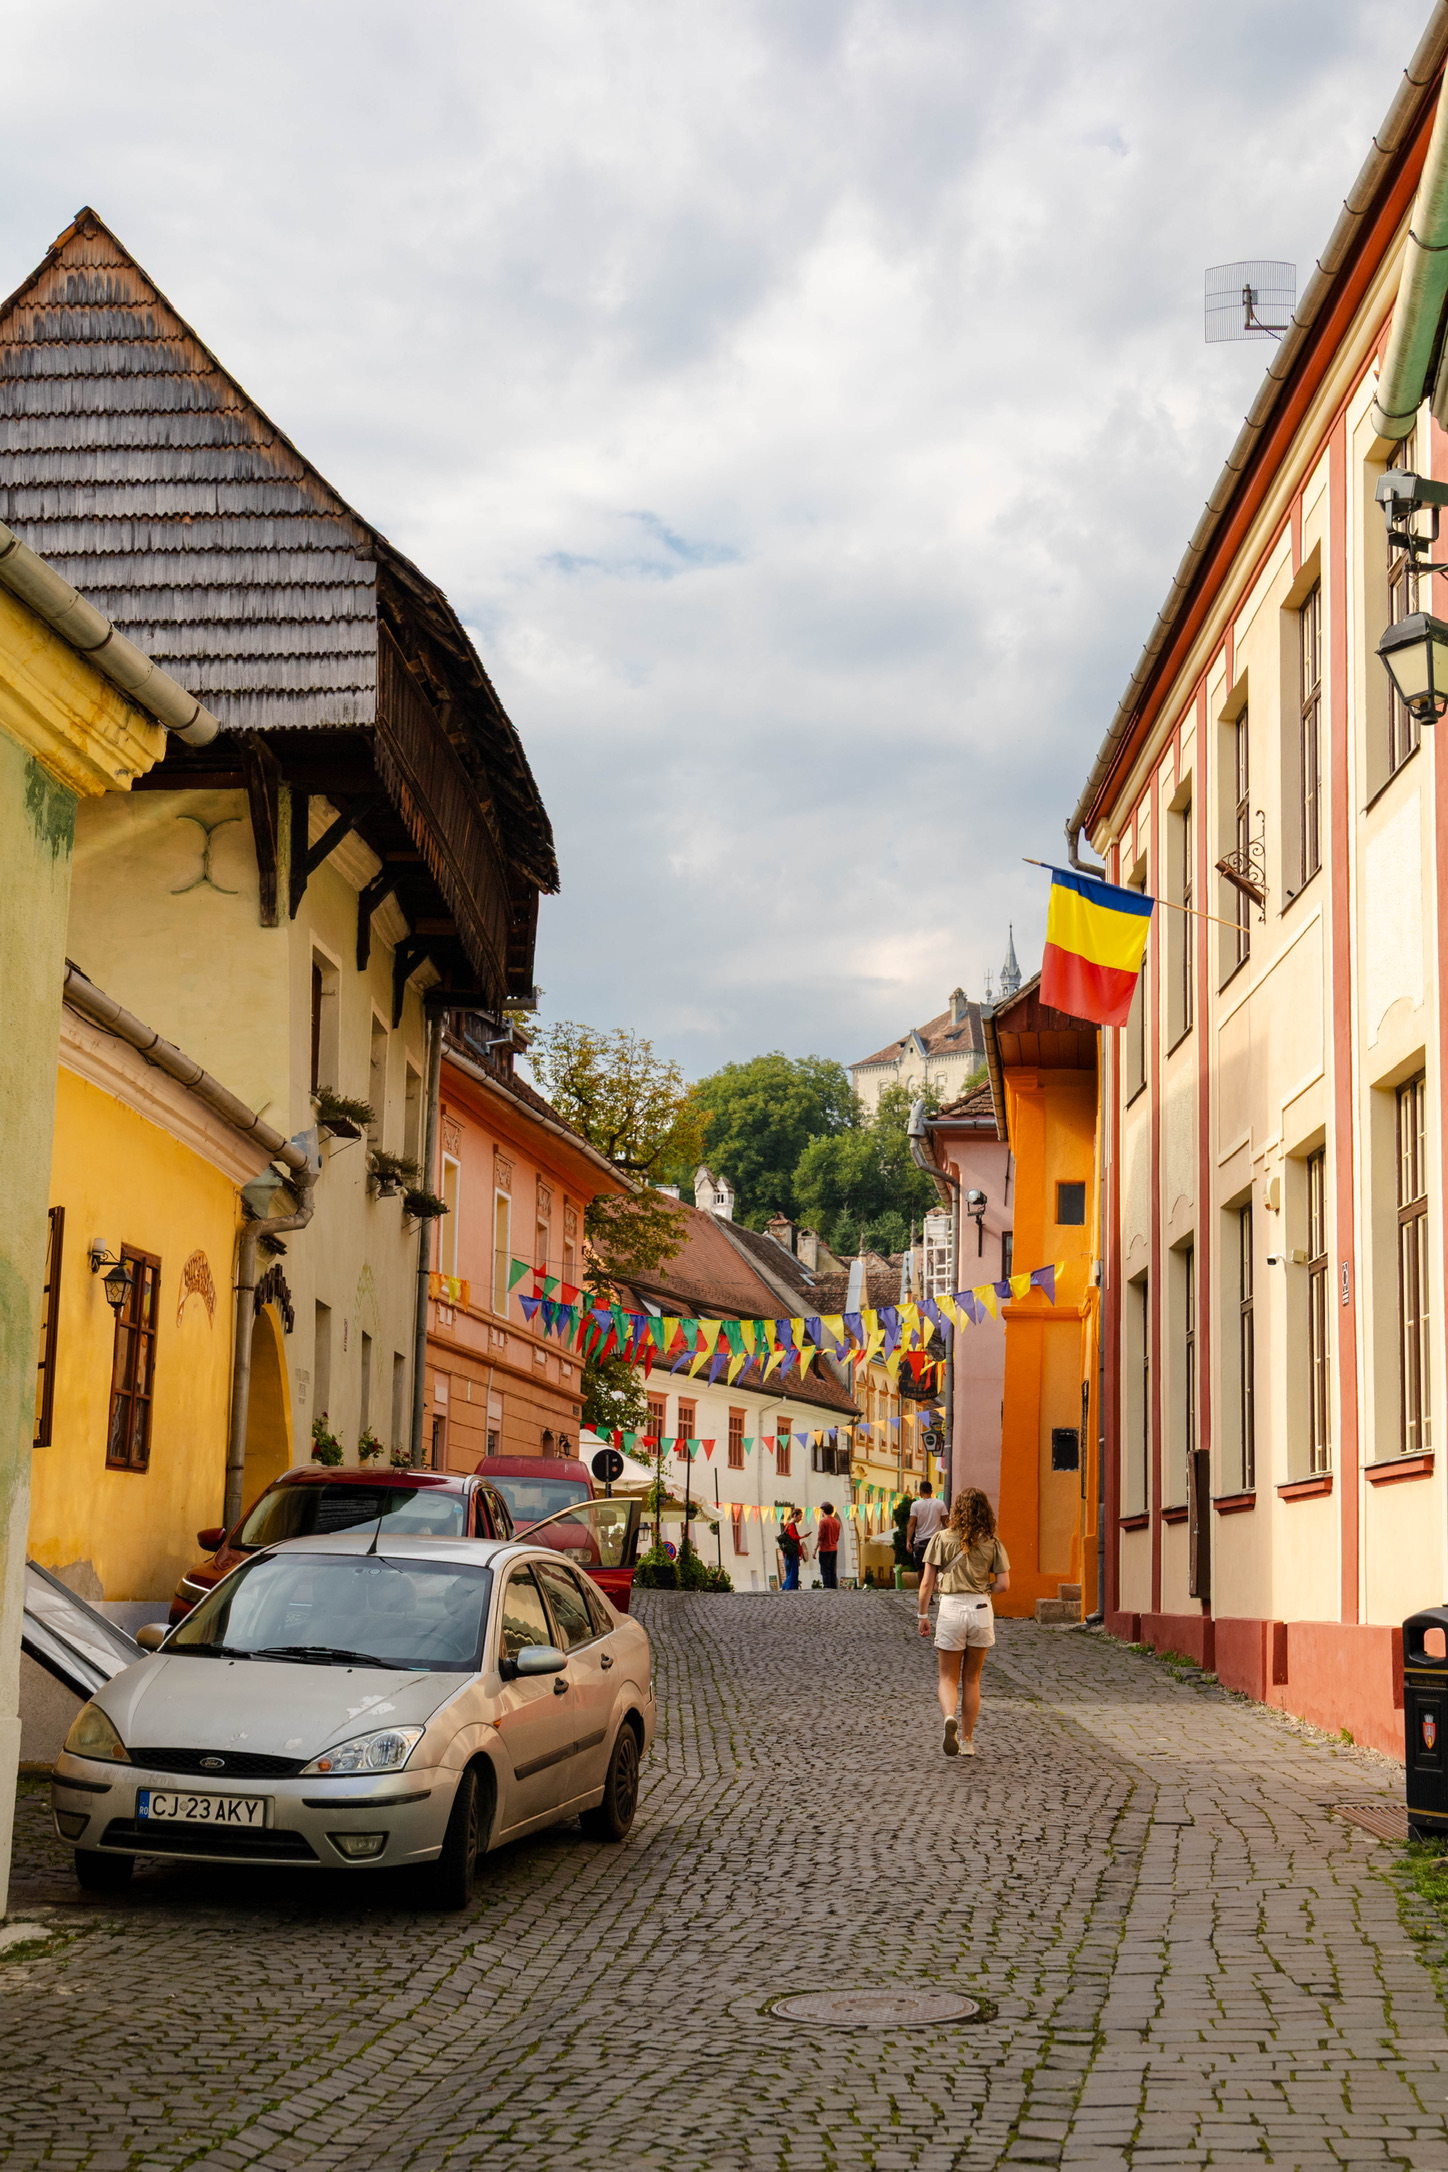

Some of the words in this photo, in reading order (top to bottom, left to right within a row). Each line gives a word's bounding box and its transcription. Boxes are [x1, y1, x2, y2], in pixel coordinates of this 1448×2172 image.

[139, 1806, 149, 1815] RO
[152, 1795, 179, 1817] CJ
[186, 1797, 211, 1819] 23
[215, 1799, 258, 1822] AKY
